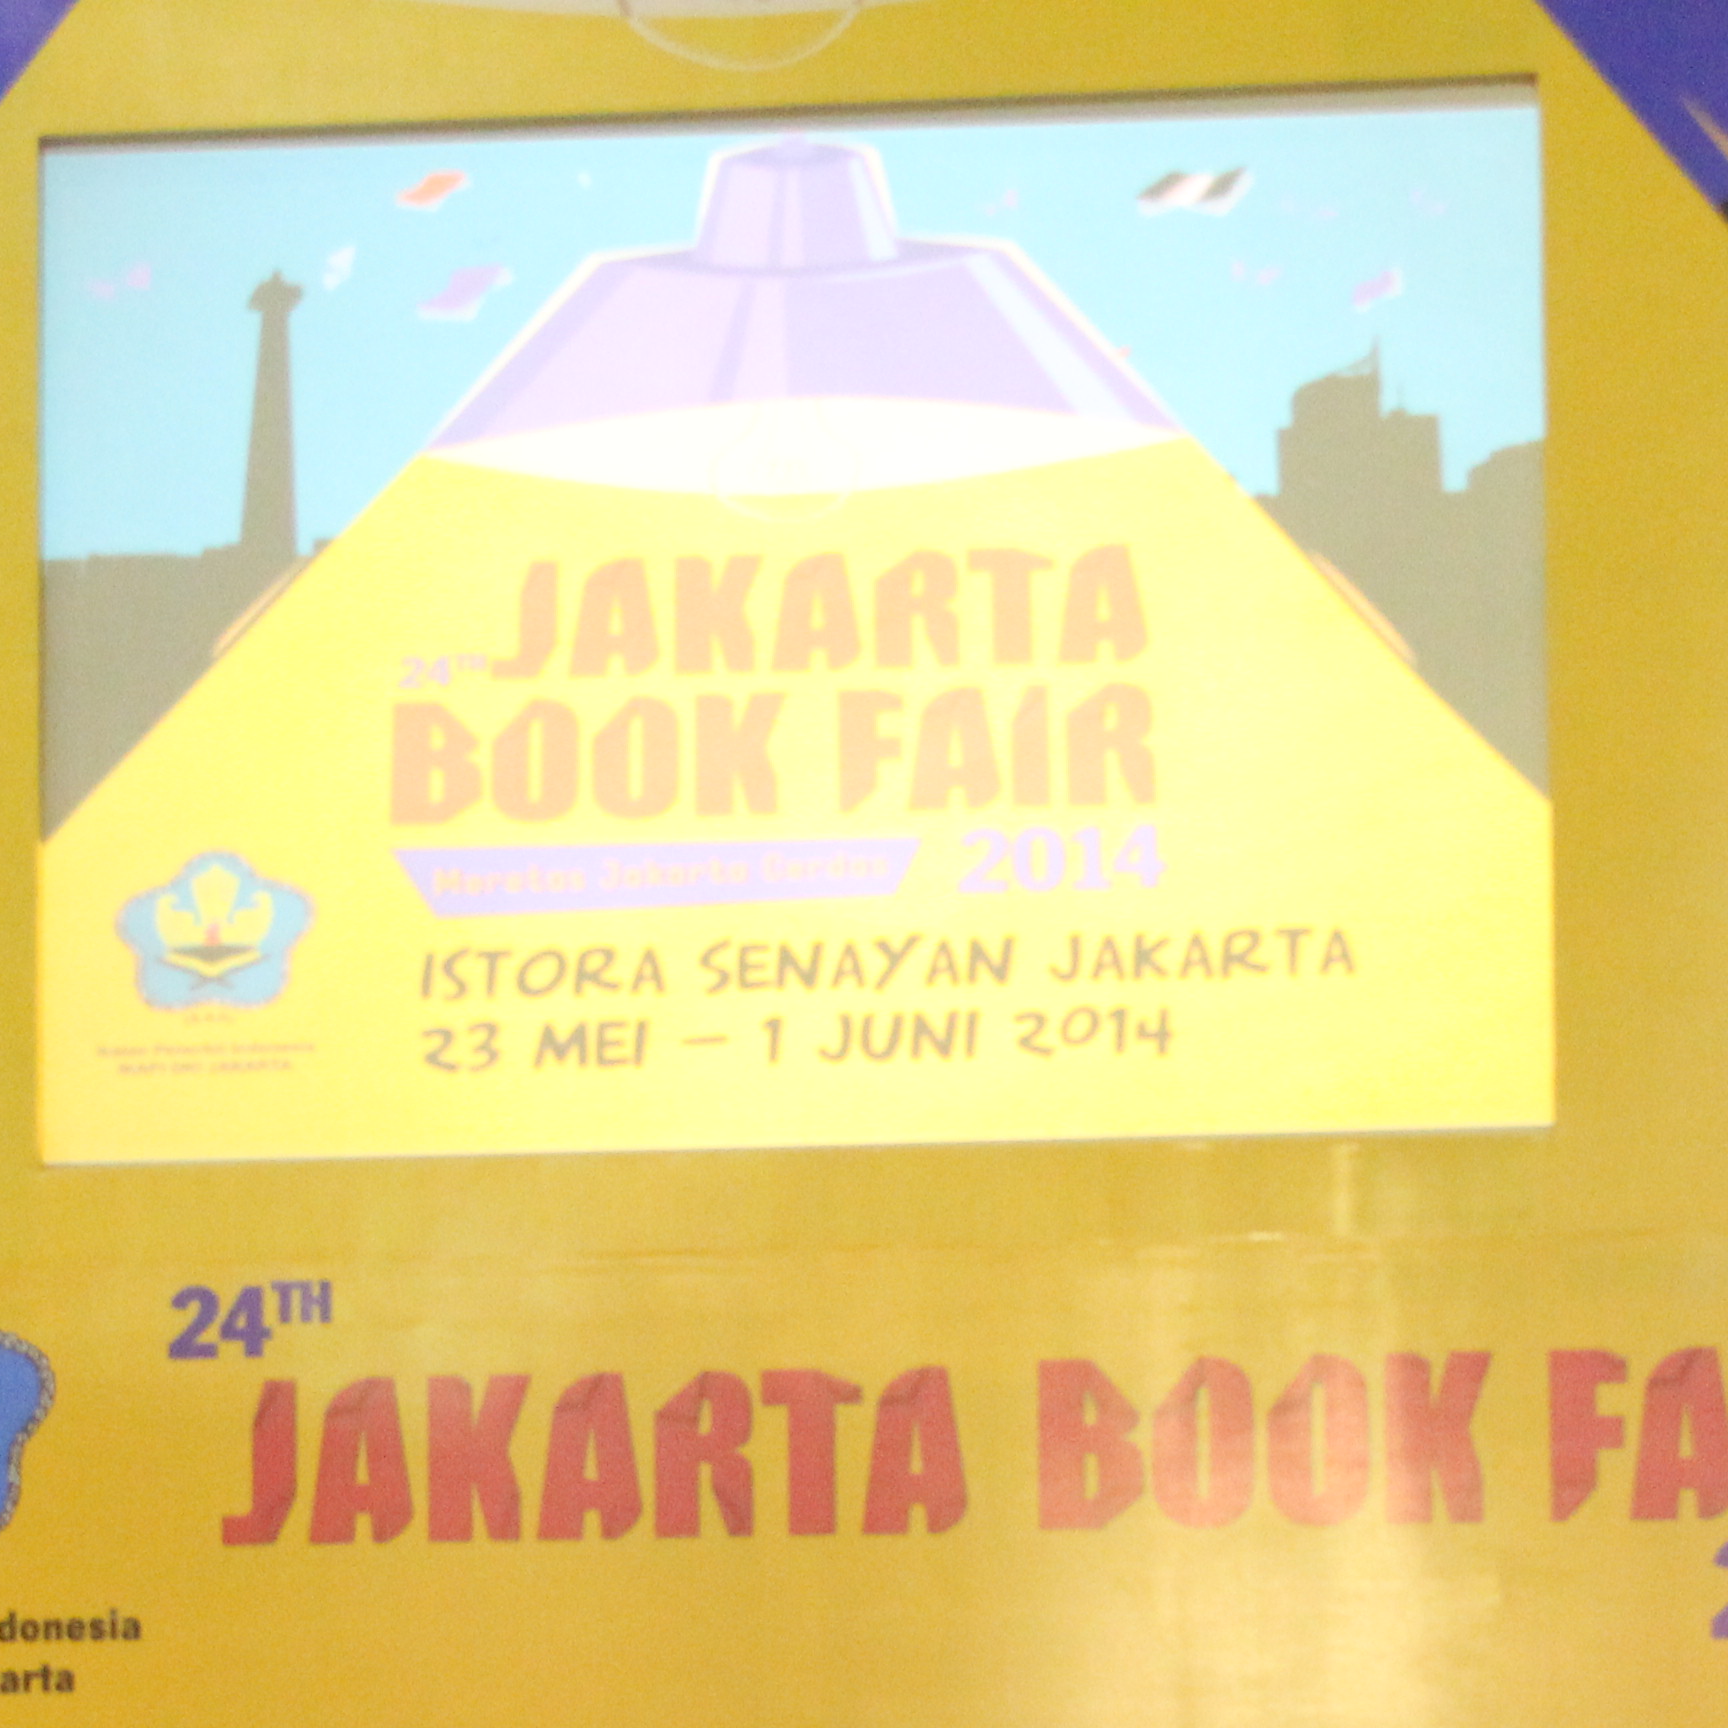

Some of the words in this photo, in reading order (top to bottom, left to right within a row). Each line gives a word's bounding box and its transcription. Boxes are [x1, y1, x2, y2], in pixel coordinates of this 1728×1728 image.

[490, 543, 1151, 679] JAKARTA
[390, 692, 785, 826] BOOK
[838, 683, 1156, 814] FAIR
[598, 858, 747, 890] Jakarta
[958, 824, 1165, 894] 2014
[419, 946, 668, 1002] ISTORA
[700, 935, 1014, 994] SENAYAN
[1050, 927, 1358, 982] JAKARTA
[421, 1024, 500, 1073] 23
[533, 1020, 647, 1069] MEI
[761, 1017, 784, 1064] 1
[818, 1013, 980, 1063] JUNI
[1014, 1008, 1175, 1058] 2014
[166, 1278, 334, 1361] 24TH
[221, 1365, 970, 1548] JAKARTA
[1035, 1349, 1494, 1529] BOOK
